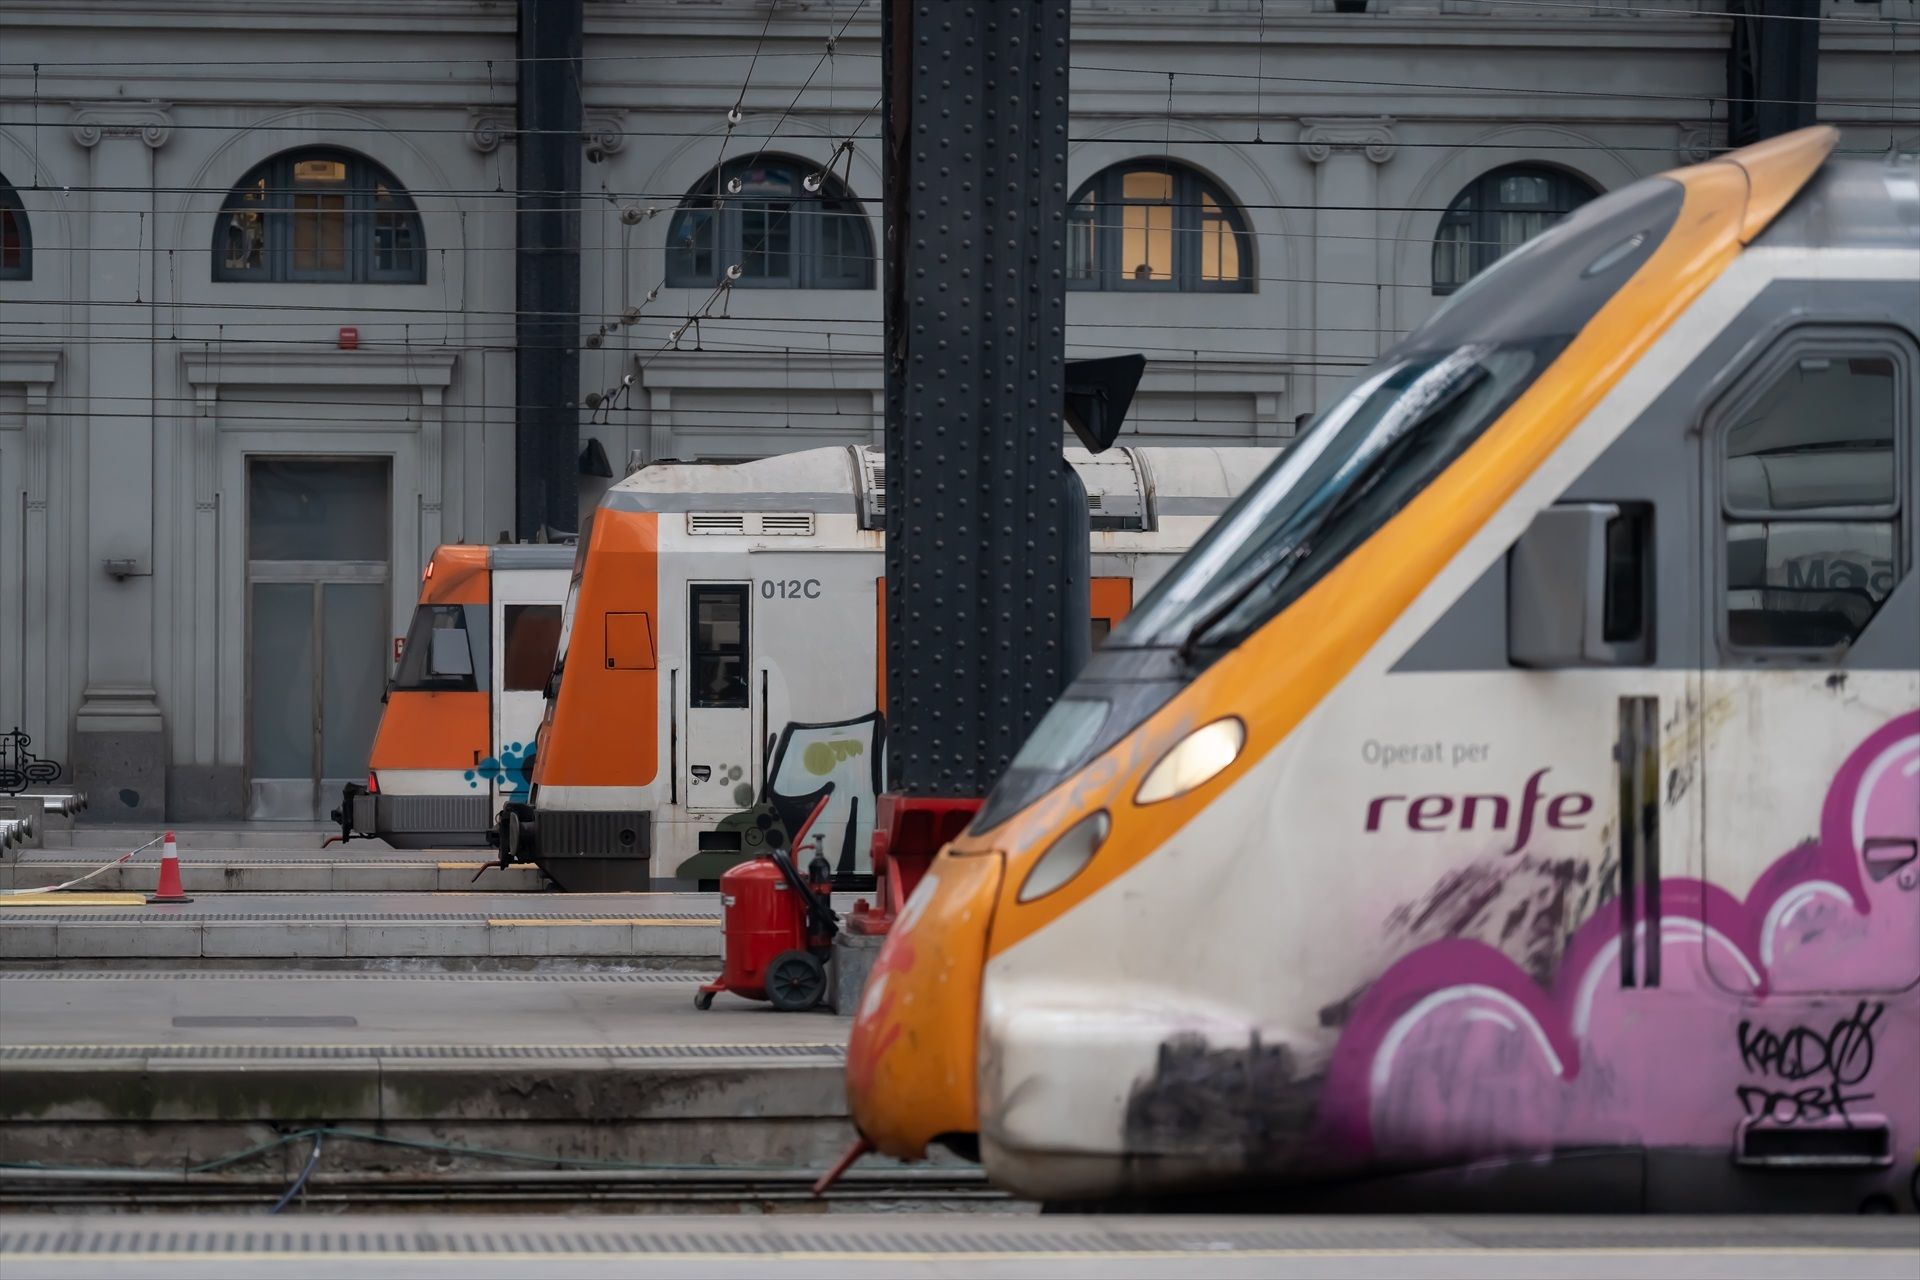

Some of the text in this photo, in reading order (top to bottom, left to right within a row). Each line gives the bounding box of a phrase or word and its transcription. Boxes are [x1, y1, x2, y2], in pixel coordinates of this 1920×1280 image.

[761, 579, 821, 599] 012C
[1361, 739, 1490, 767] Operat per
[1363, 766, 1595, 856] renfe
